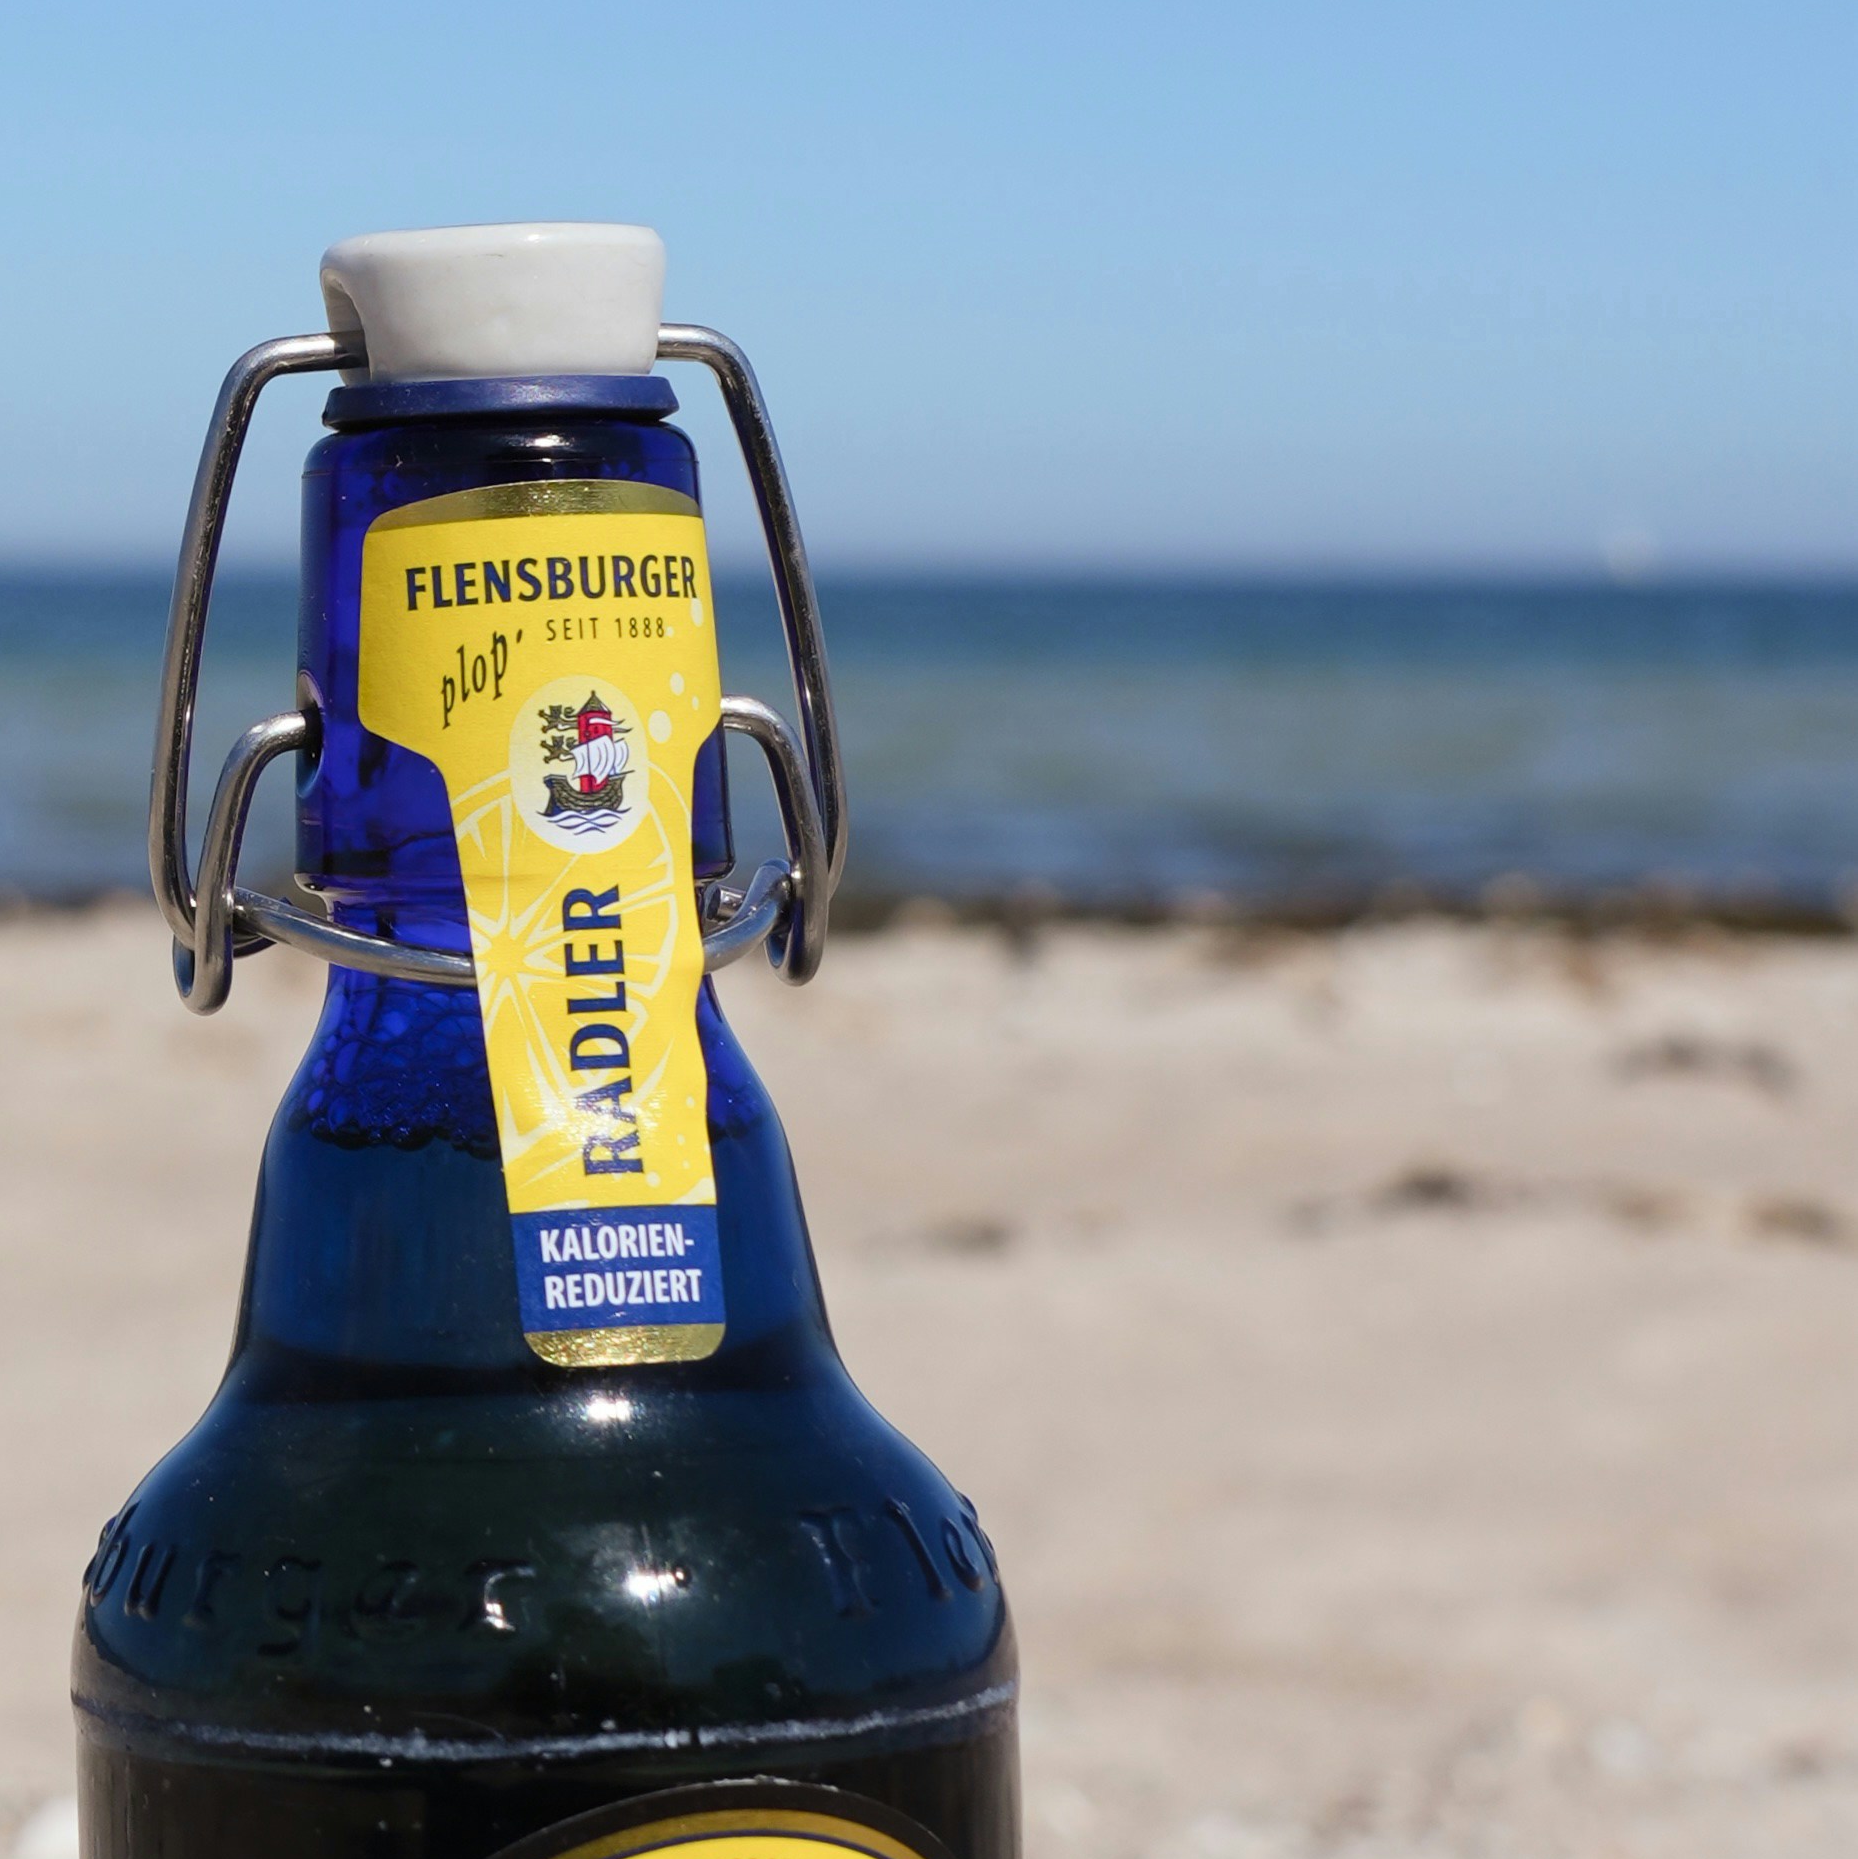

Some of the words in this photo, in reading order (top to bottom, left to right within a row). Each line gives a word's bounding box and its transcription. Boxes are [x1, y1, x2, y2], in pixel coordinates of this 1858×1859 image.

[405, 555, 697, 611] FLENSBURGER
[546, 617, 599, 641] SEIT
[615, 617, 665, 639] 1888
[562, 884, 644, 1176] RADLER
[539, 1223, 694, 1263] KALORIEN-
[544, 1269, 702, 1309] REDUZIERT
